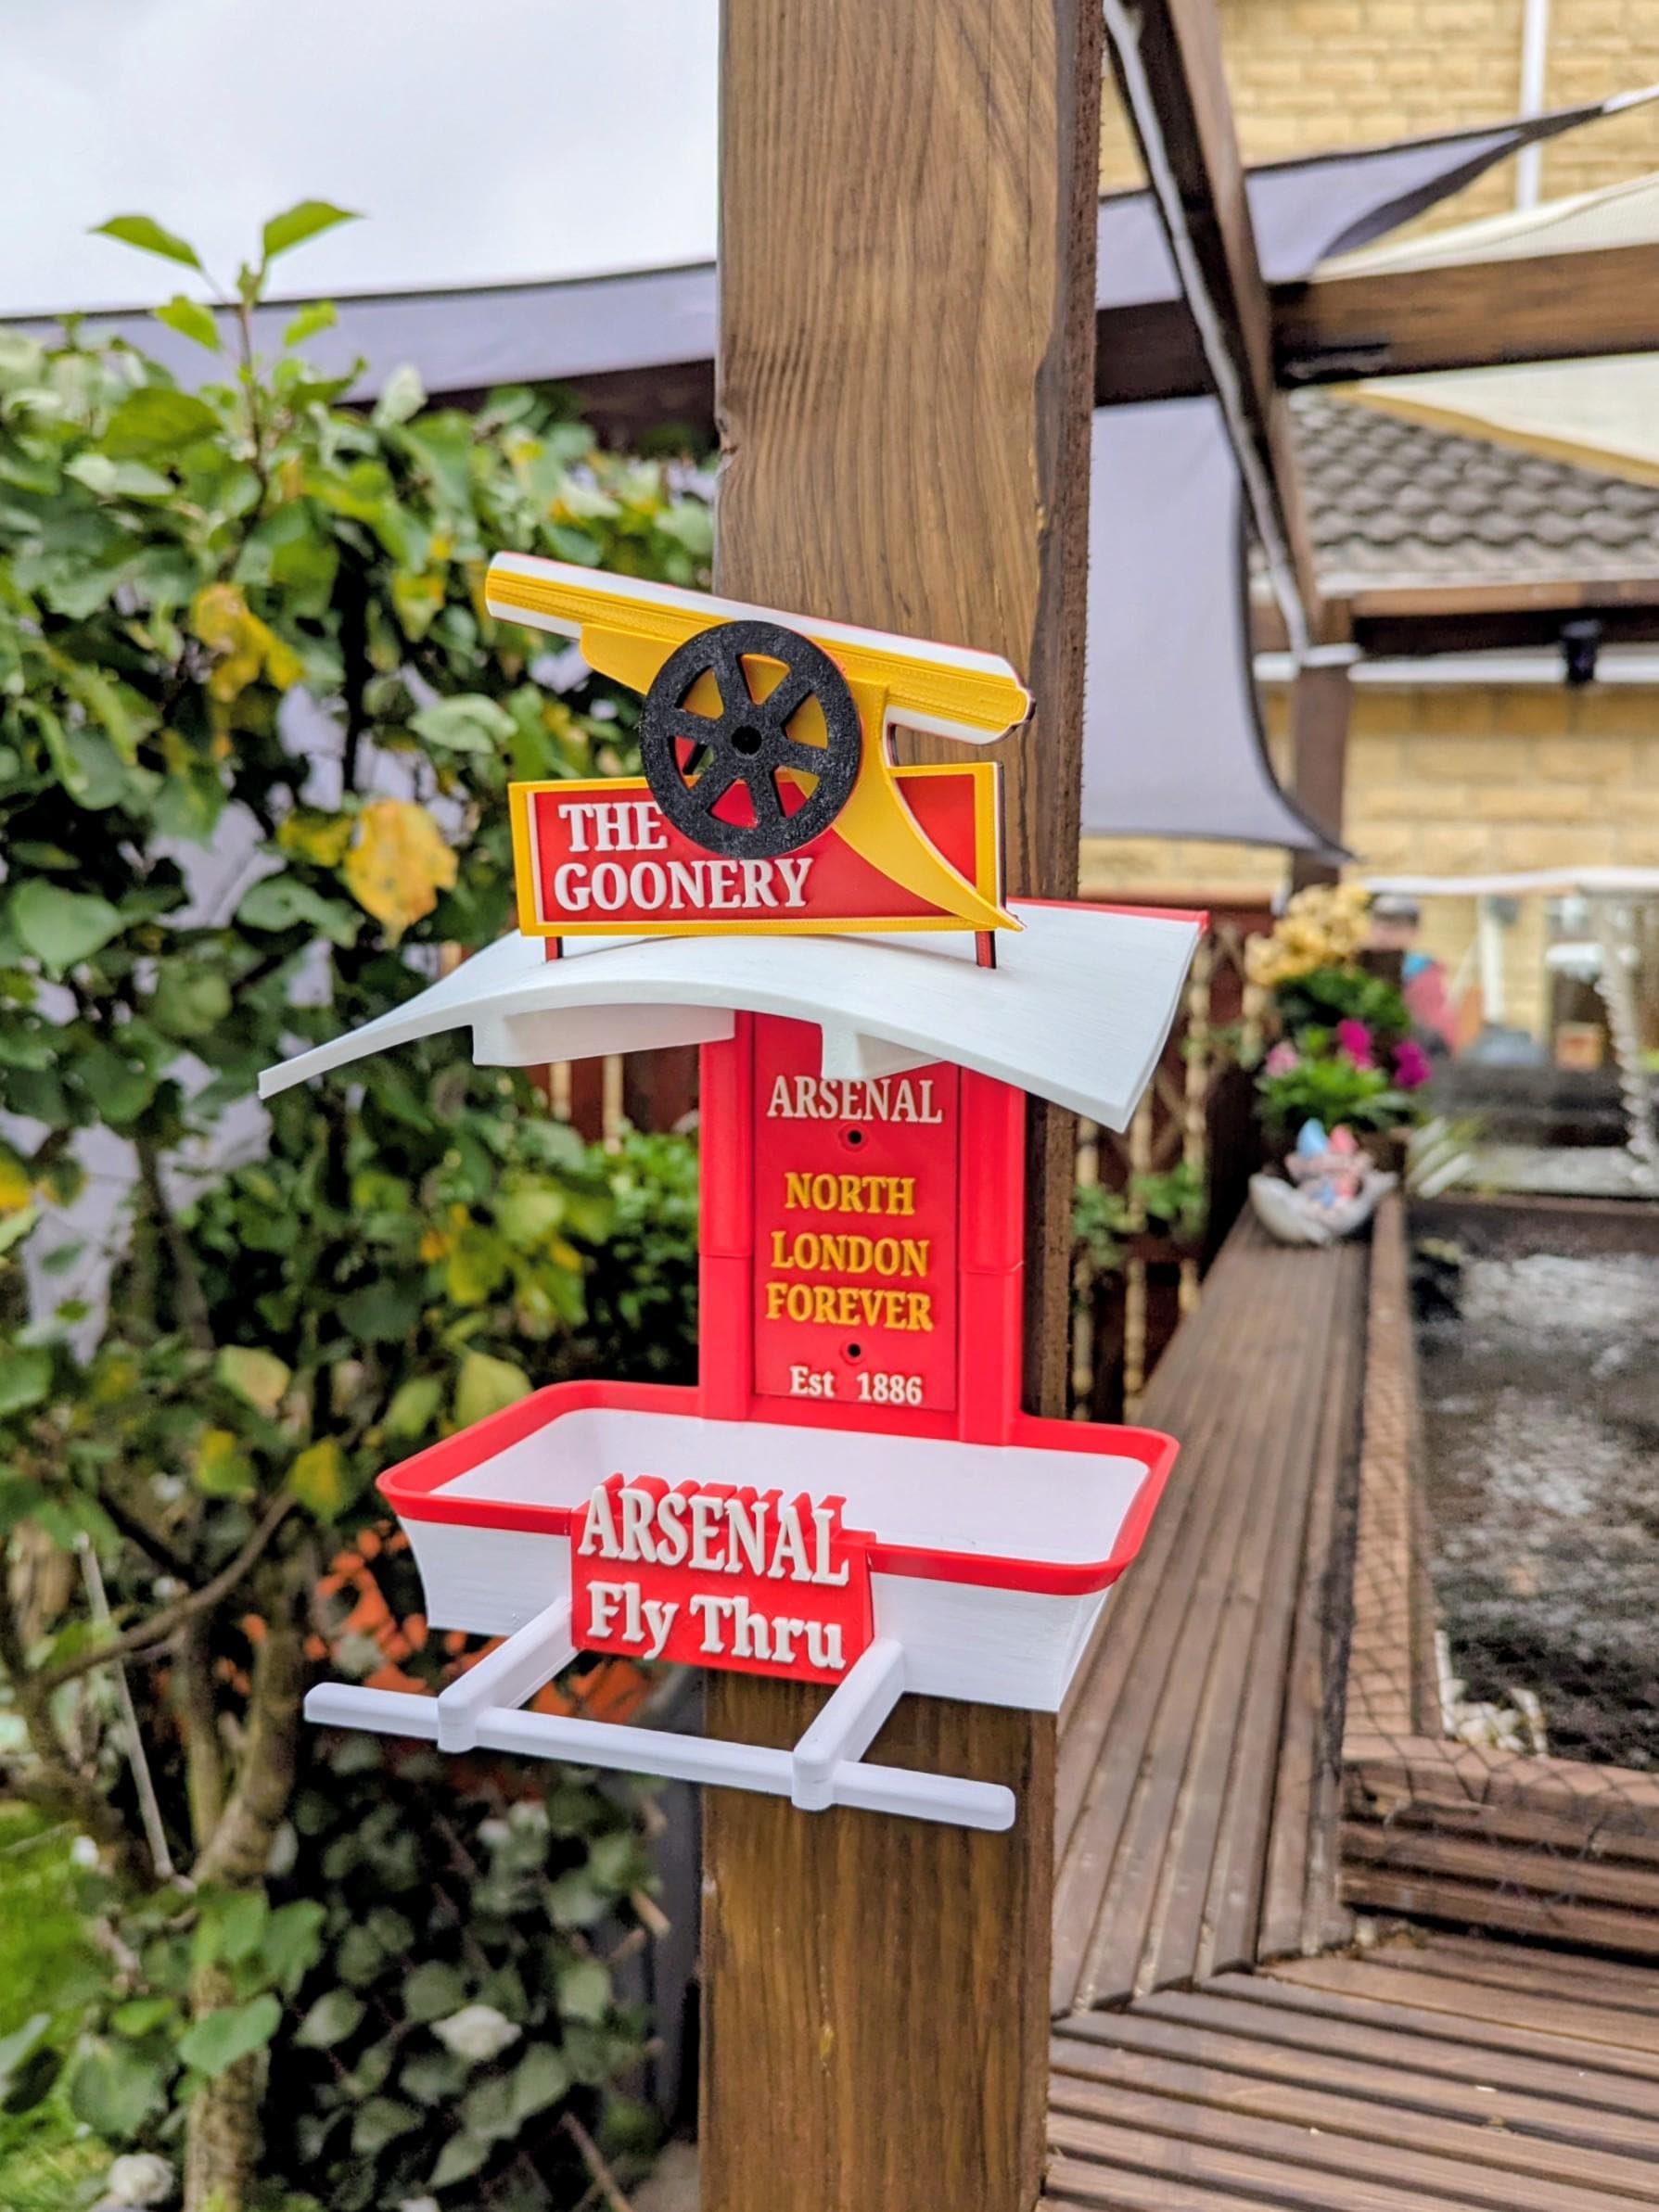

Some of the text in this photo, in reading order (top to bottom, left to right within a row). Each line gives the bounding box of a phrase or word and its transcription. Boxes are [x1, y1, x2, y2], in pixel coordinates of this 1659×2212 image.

[558, 801, 668, 852] THE
[555, 858, 812, 911] GOONERY
[767, 1074, 942, 1124] ARSENAL
[785, 1172, 915, 1215] NORTH
[771, 1230, 929, 1277] LONDON
[766, 1282, 933, 1331] FOREVER
[789, 1366, 923, 1406] Est 1886
[578, 1483, 849, 1587] ARSENAL
[586, 1580, 846, 1670] Fly Thru
